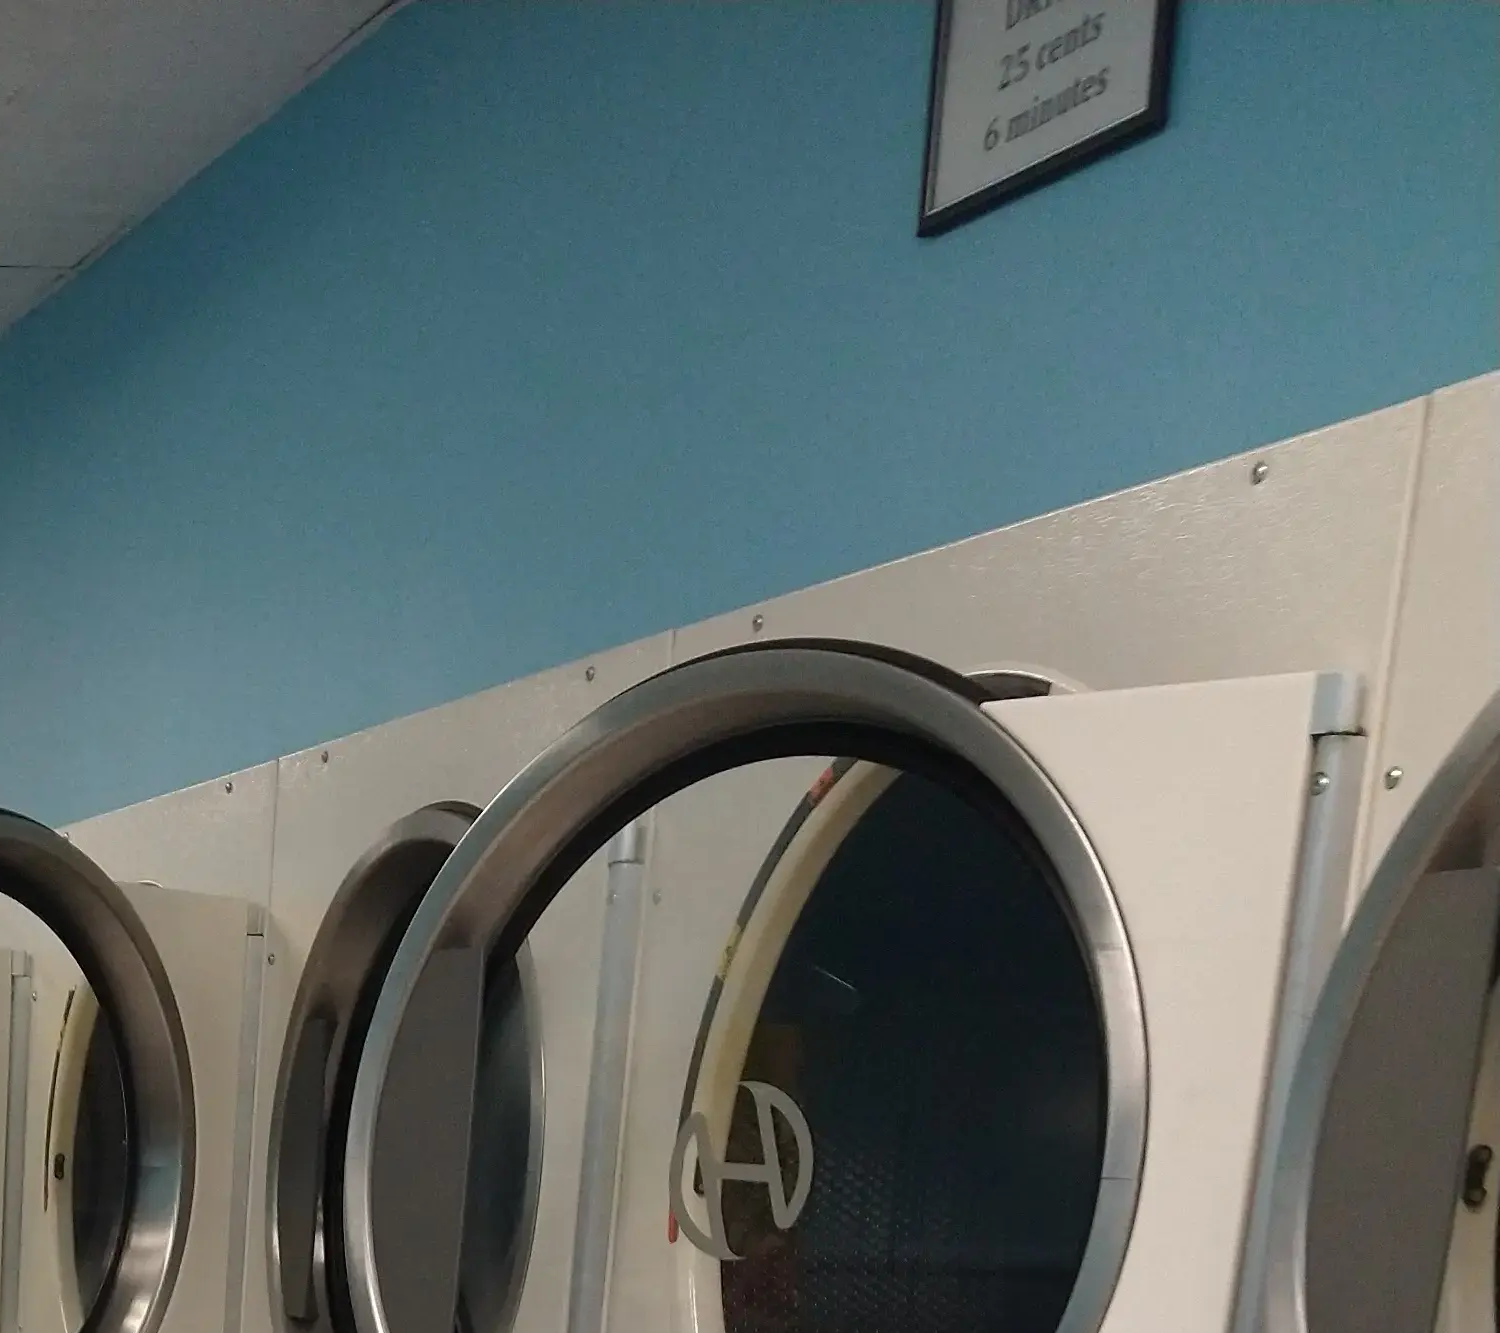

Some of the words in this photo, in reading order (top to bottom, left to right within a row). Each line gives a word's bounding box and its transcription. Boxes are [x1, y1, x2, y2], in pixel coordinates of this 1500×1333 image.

[998, 42, 1031, 91] 25
[1035, 12, 1106, 71] cents
[984, 116, 1000, 152] 6
[1004, 65, 1111, 143] minutes
